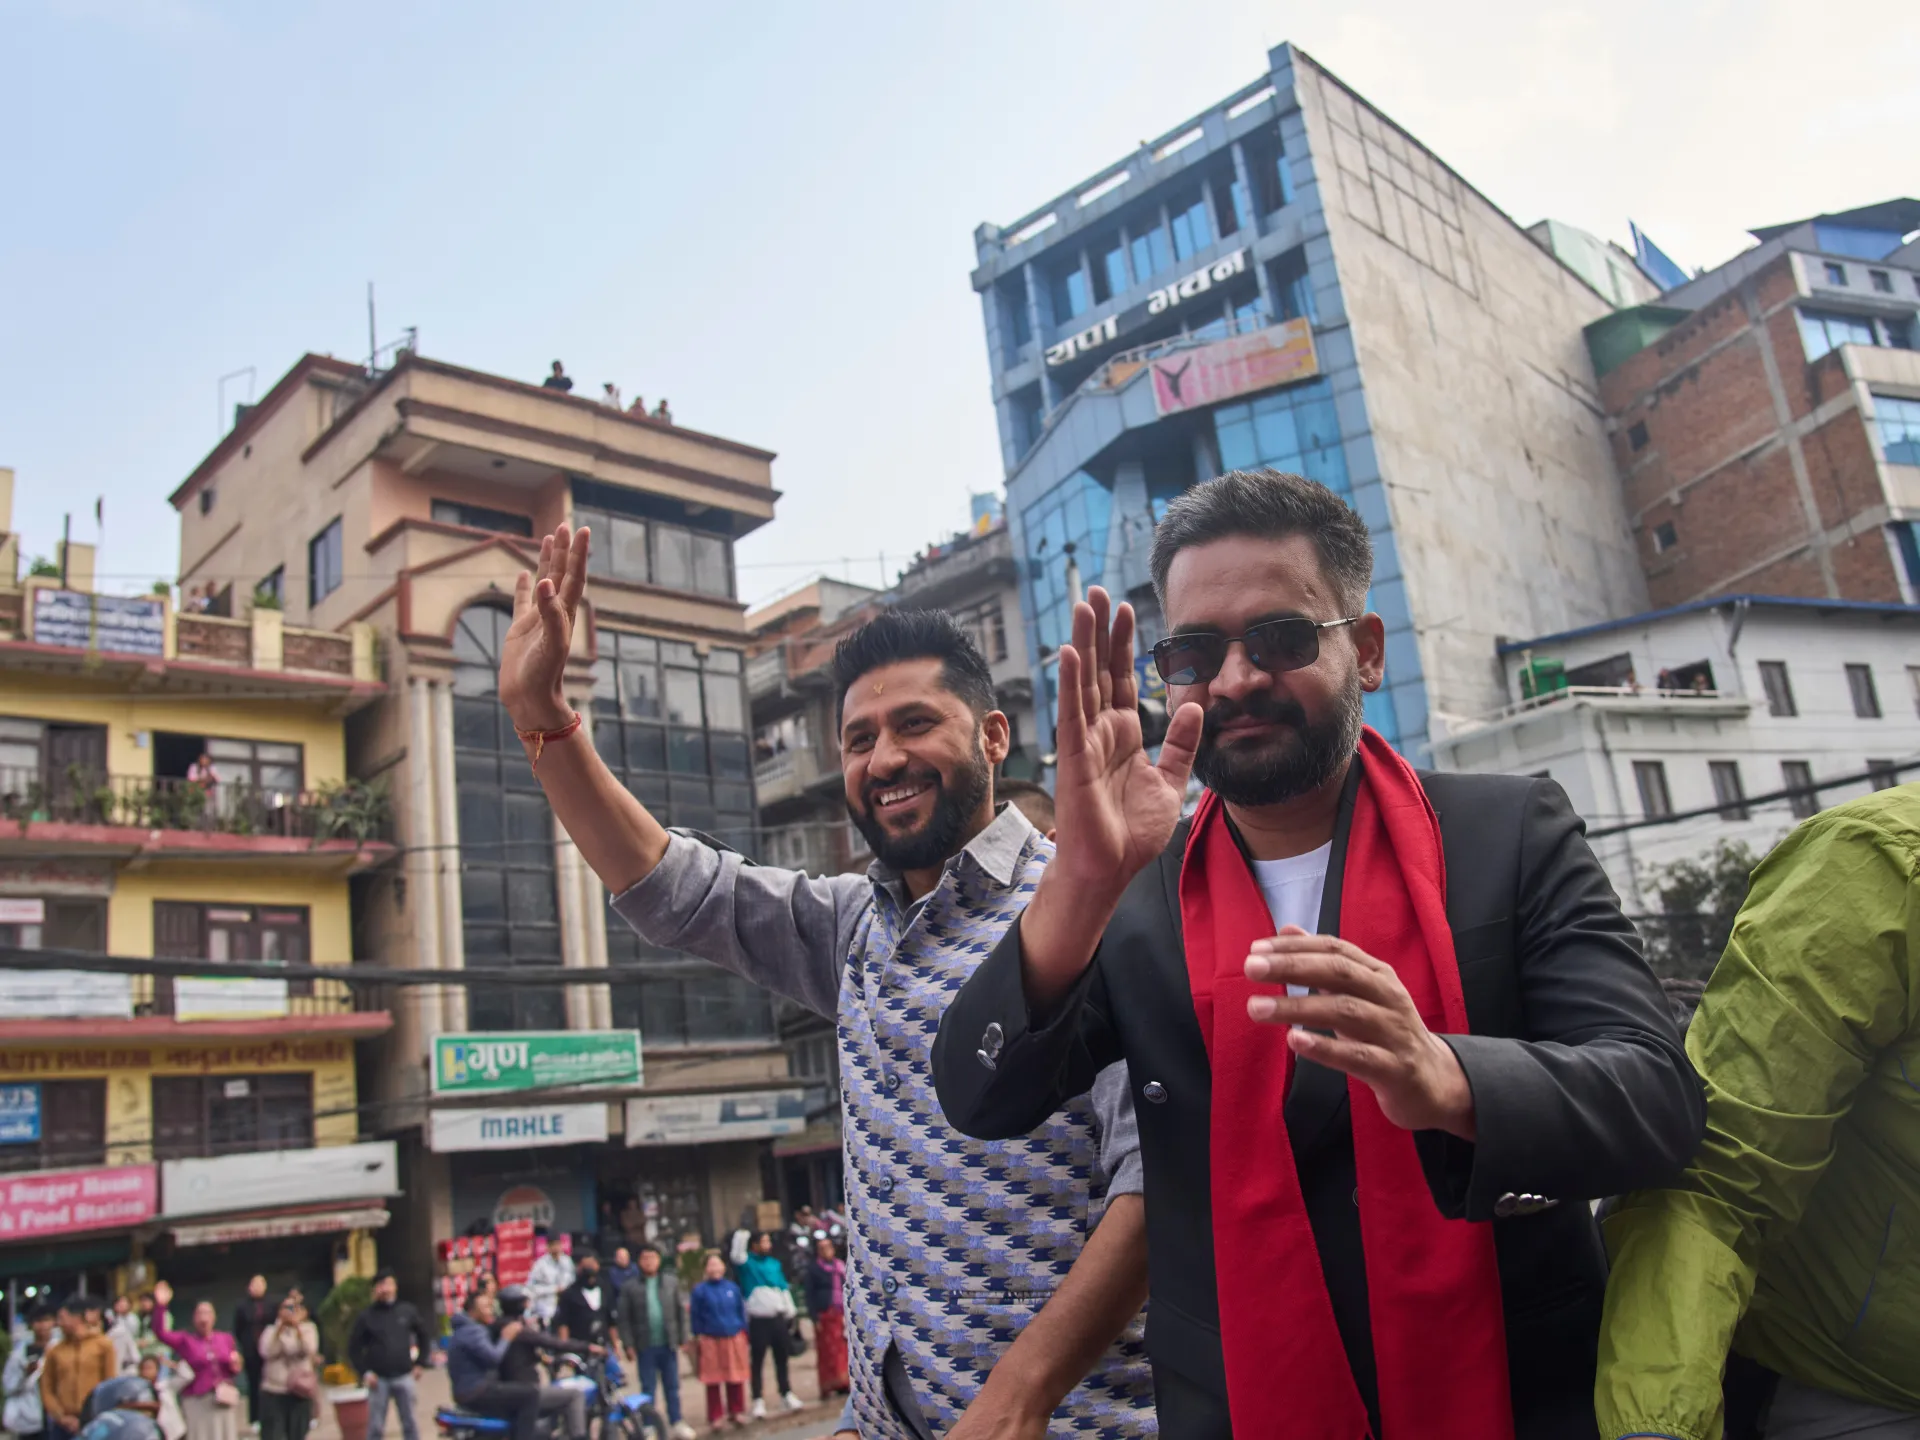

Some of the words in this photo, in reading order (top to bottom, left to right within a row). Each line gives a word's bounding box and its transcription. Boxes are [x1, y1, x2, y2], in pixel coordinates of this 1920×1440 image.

[468, 1041, 530, 1080] गुण
[480, 1114, 564, 1138] MAHLE
[10, 1181, 79, 1205] Burger
[82, 1175, 142, 1197] House
[19, 1205, 70, 1230] Food
